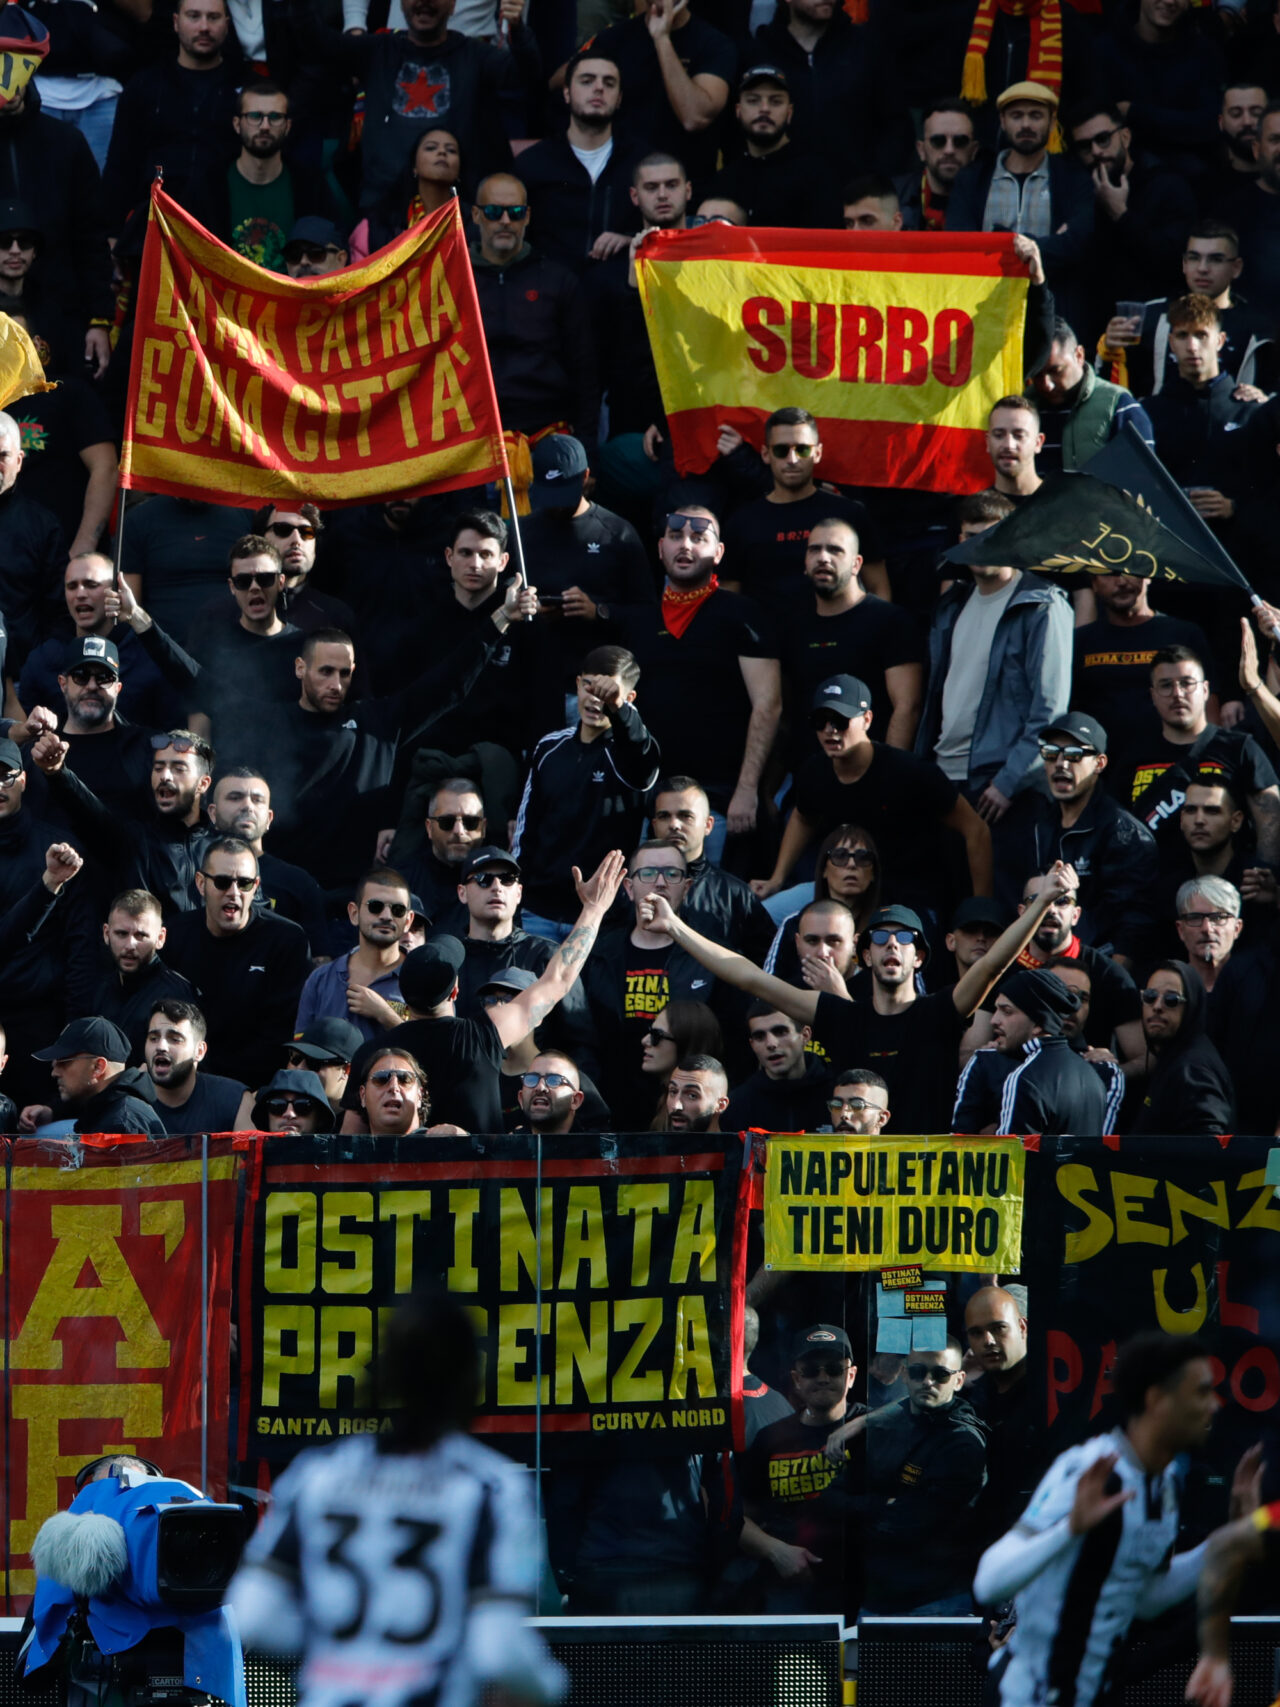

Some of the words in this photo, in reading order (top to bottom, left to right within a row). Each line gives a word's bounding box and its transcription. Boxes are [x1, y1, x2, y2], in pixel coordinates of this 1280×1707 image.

[295, 251, 463, 374] PATRIA
[741, 296, 975, 388] SURBO
[1134, 652, 1155, 664] LEC
[1145, 788, 1187, 831] FILA
[780, 1151, 1010, 1198] NAPULETANU
[263, 1179, 717, 1295] OSTINATA
[788, 1206, 883, 1255] TIENI
[898, 1206, 999, 1257] DURO
[881, 1267, 921, 1280] OSTINATA
[882, 1275, 923, 1288] PRESENZA
[905, 1293, 945, 1302] OSTINATA
[905, 1302, 945, 1310] PRESENZA
[260, 1294, 717, 1410] PRENZA
[256, 1416, 334, 1436] SANTA
[338, 1416, 395, 1435] ROSA
[591, 1411, 666, 1432] CURVA
[670, 1408, 726, 1429] NORD
[320, 1511, 445, 1646] 33
